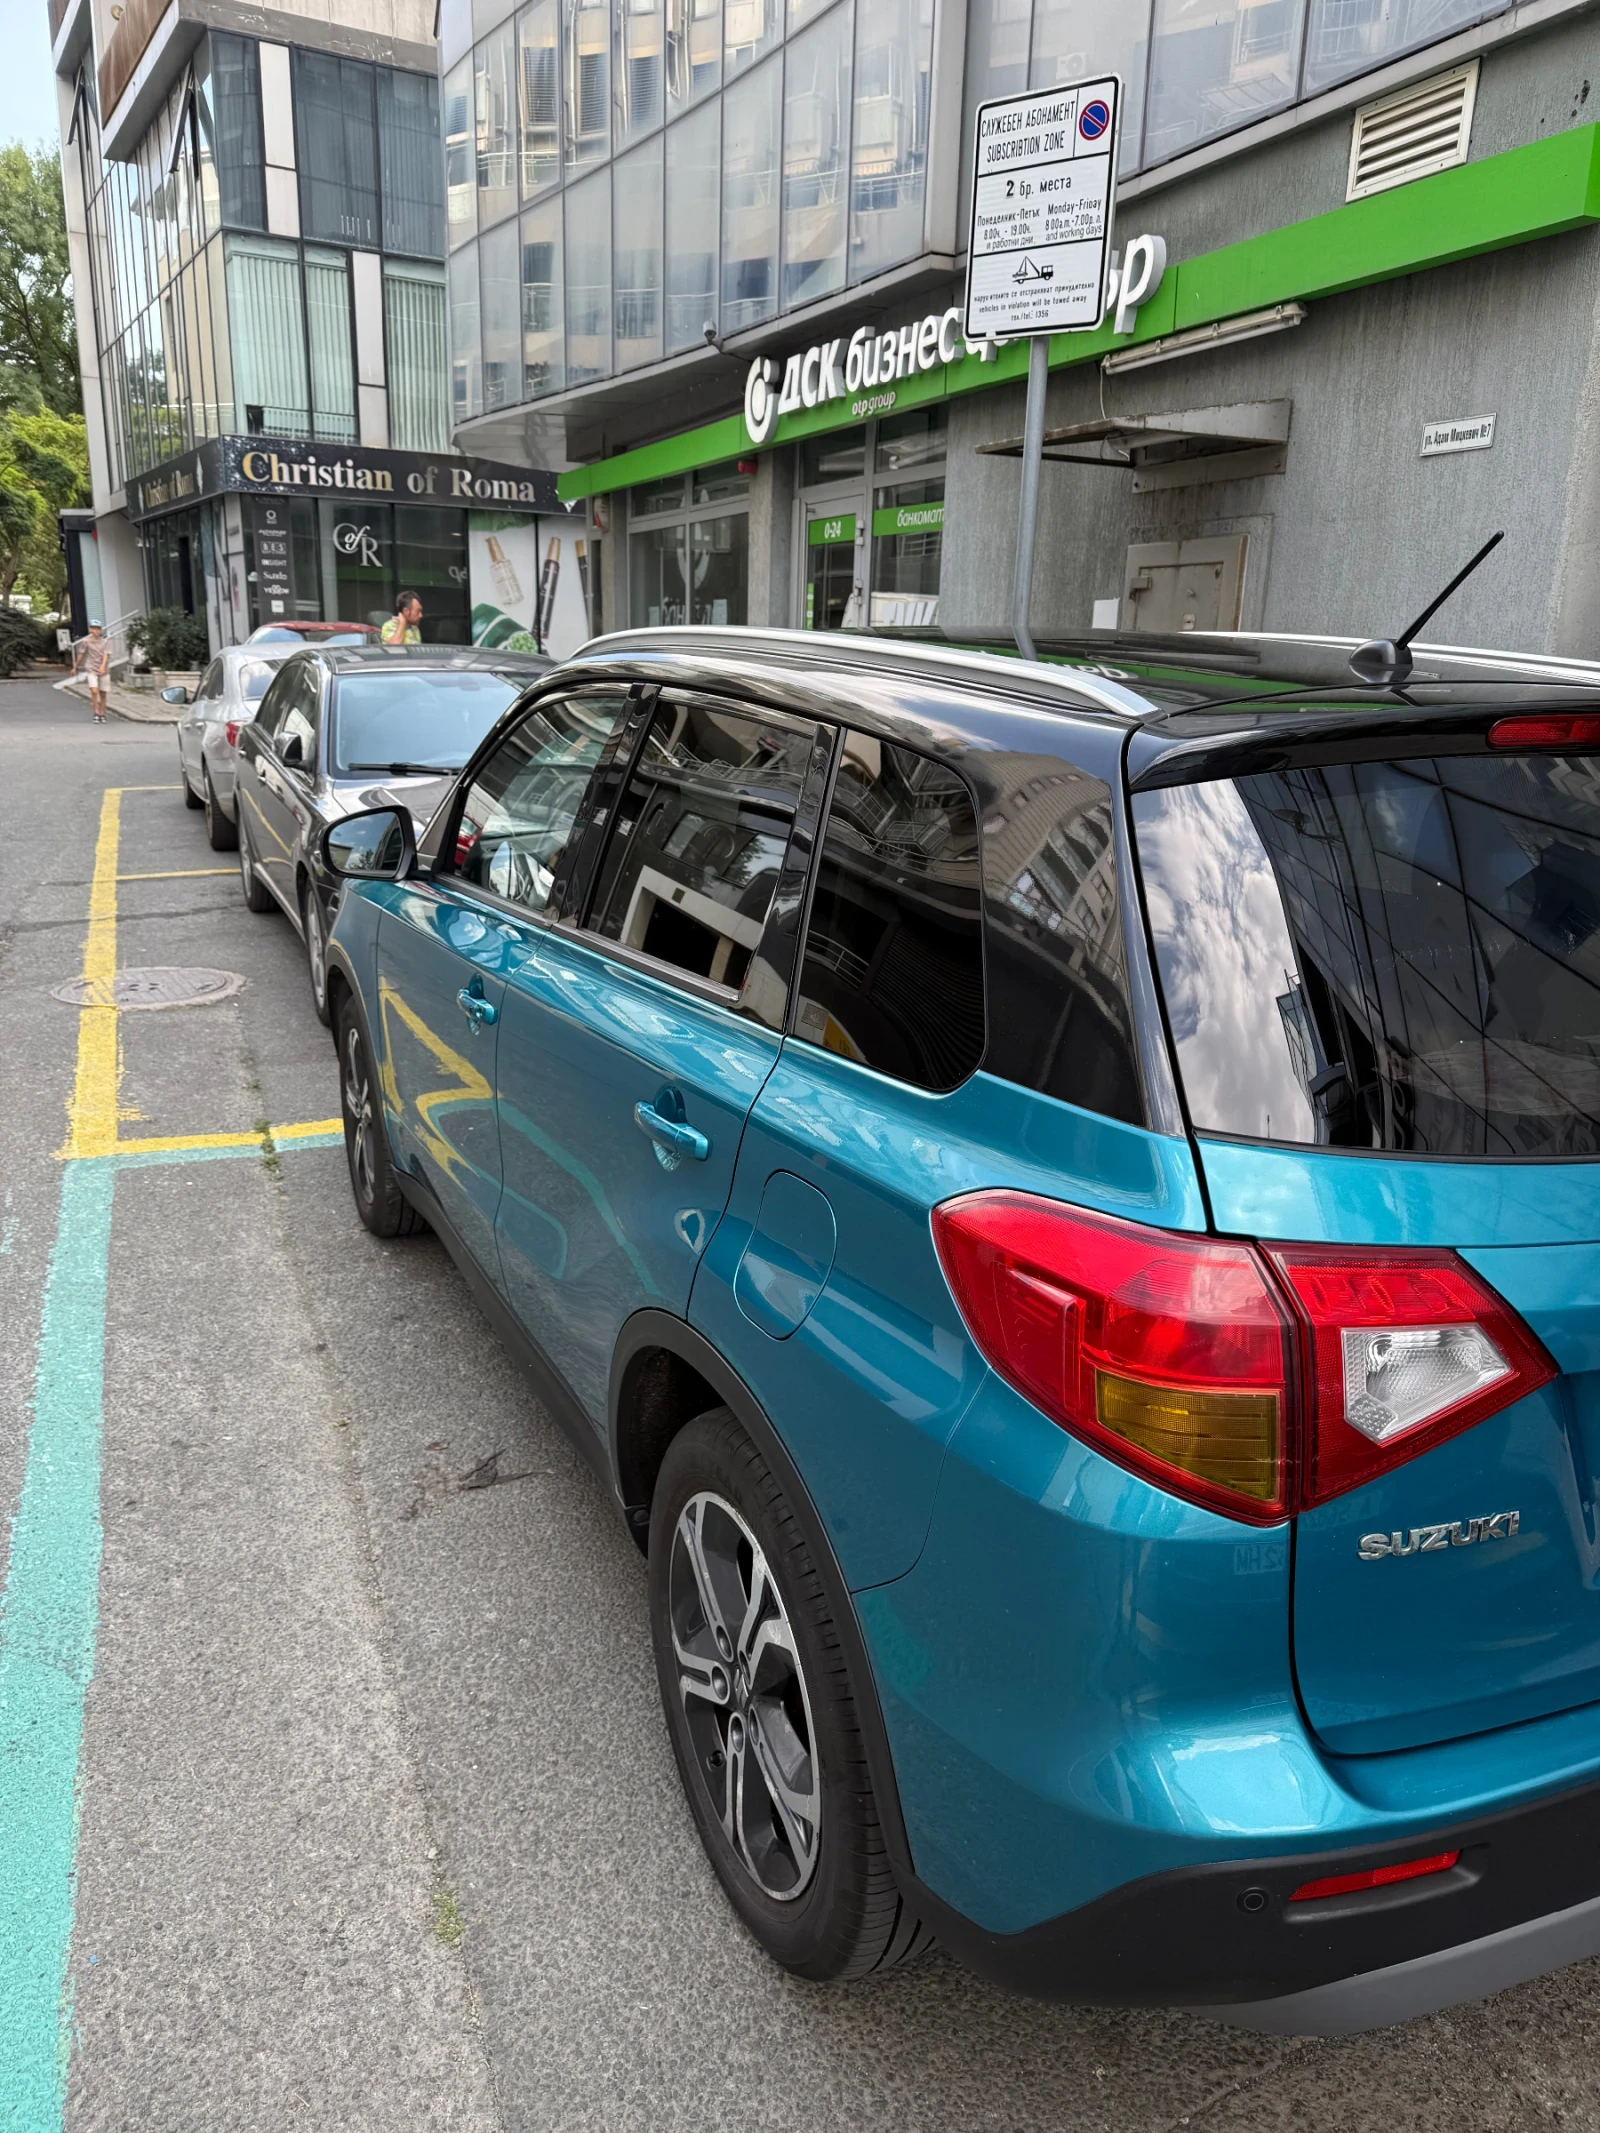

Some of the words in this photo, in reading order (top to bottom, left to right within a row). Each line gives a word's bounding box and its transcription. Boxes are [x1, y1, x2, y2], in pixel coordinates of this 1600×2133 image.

[981, 112, 1023, 138] СЛУЖЕБЕН
[1025, 101, 1075, 129] АБОНАМЕНТ
[987, 136, 1041, 163] SUBSCRIBTION
[1044, 130, 1066, 152] ZONE
[1006, 180, 1015, 197] 2
[1020, 181, 1034, 199] бр.
[1040, 177, 1072, 193] места
[1046, 230, 1058, 241] and
[1059, 227, 1085, 239] working
[1086, 224, 1102, 236] days
[979, 304, 999, 313] vehicles
[1008, 300, 1030, 310] violation
[1032, 298, 1042, 306] will
[1044, 298, 1051, 306] be
[1053, 295, 1070, 304] towed
[1072, 295, 1087, 303] away
[1035, 310, 1049, 319] 1356
[777, 338, 847, 415] ДСК
[845, 307, 964, 393] бизнес
[852, 400, 868, 417] otp
[868, 391, 896, 415] group
[1423, 435, 1433, 450] ул.
[242, 451, 394, 492] Christian
[407, 465, 439, 494] of
[450, 468, 536, 503] Roma
[824, 521, 841, 539] 0-24
[1358, 1510, 1520, 1561] SUZUKI
